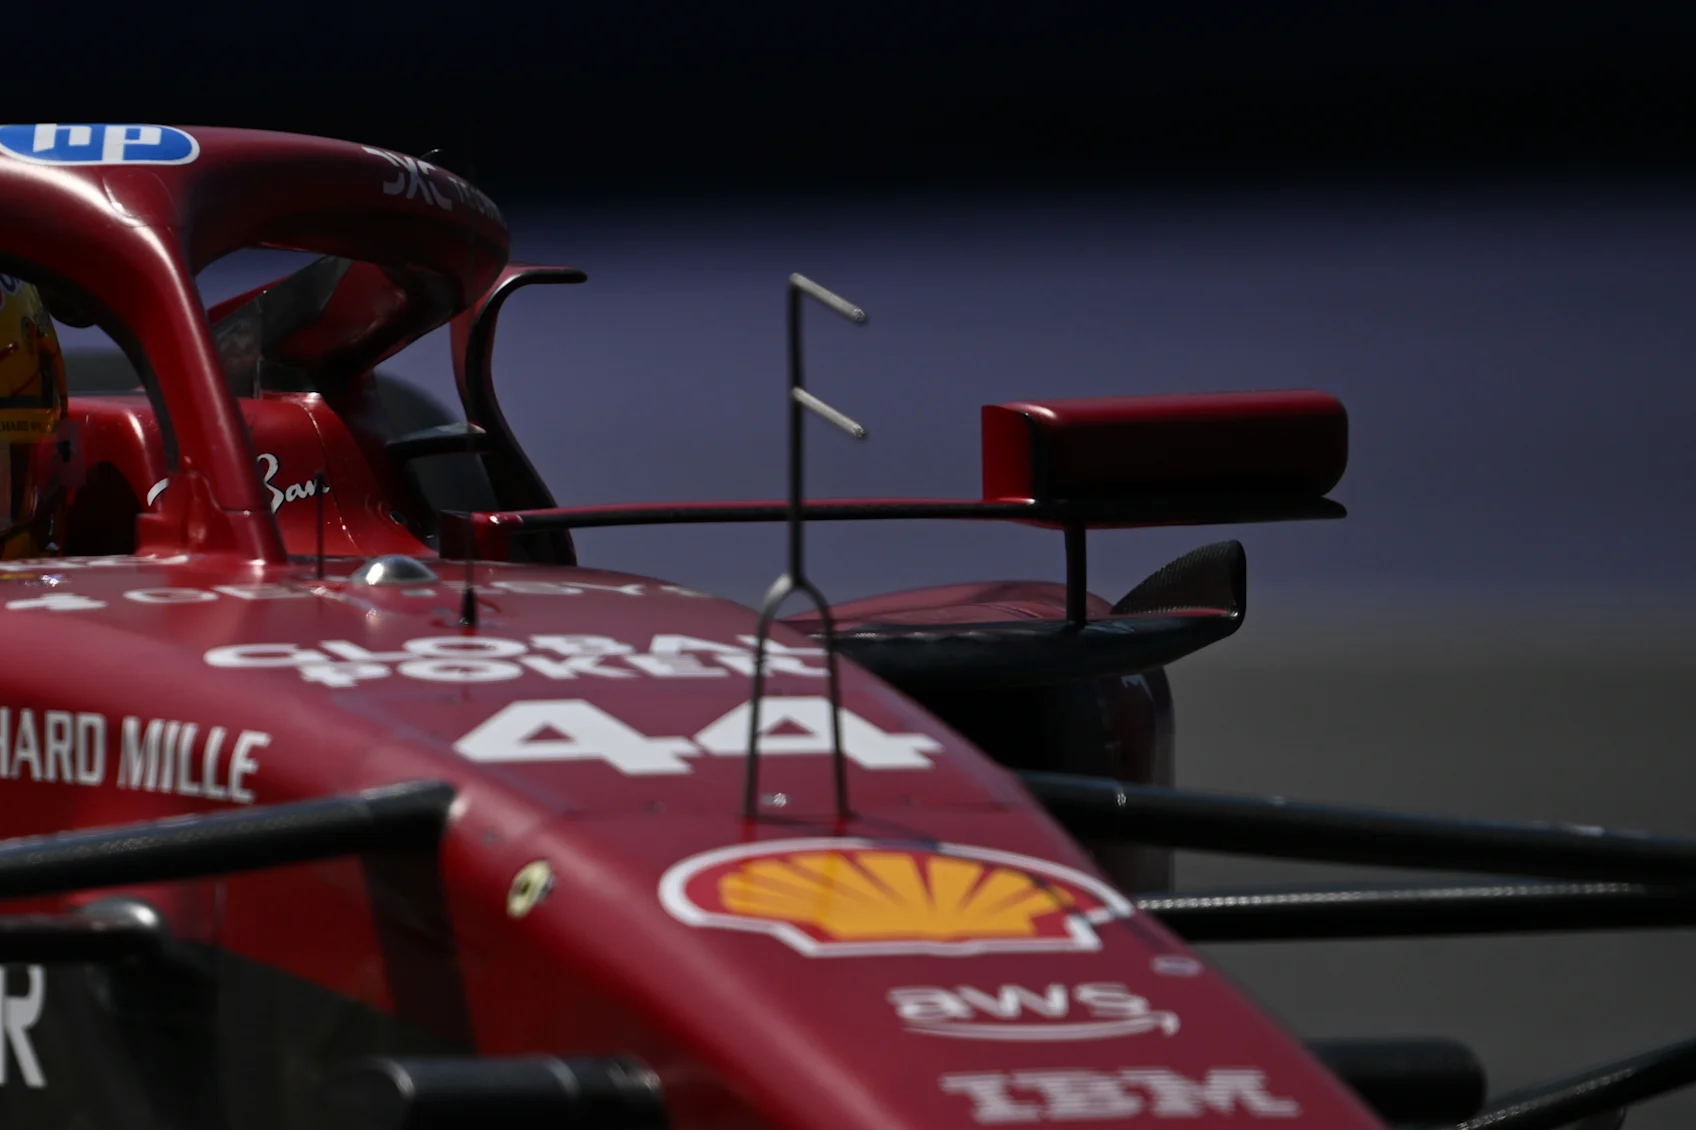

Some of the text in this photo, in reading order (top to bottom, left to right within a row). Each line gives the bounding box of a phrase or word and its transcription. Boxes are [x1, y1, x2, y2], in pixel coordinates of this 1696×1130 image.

[32, 123, 162, 163] hp
[117, 716, 272, 803] MILLE
[453, 696, 945, 776] 44
[937, 1066, 1302, 1125] IBM
